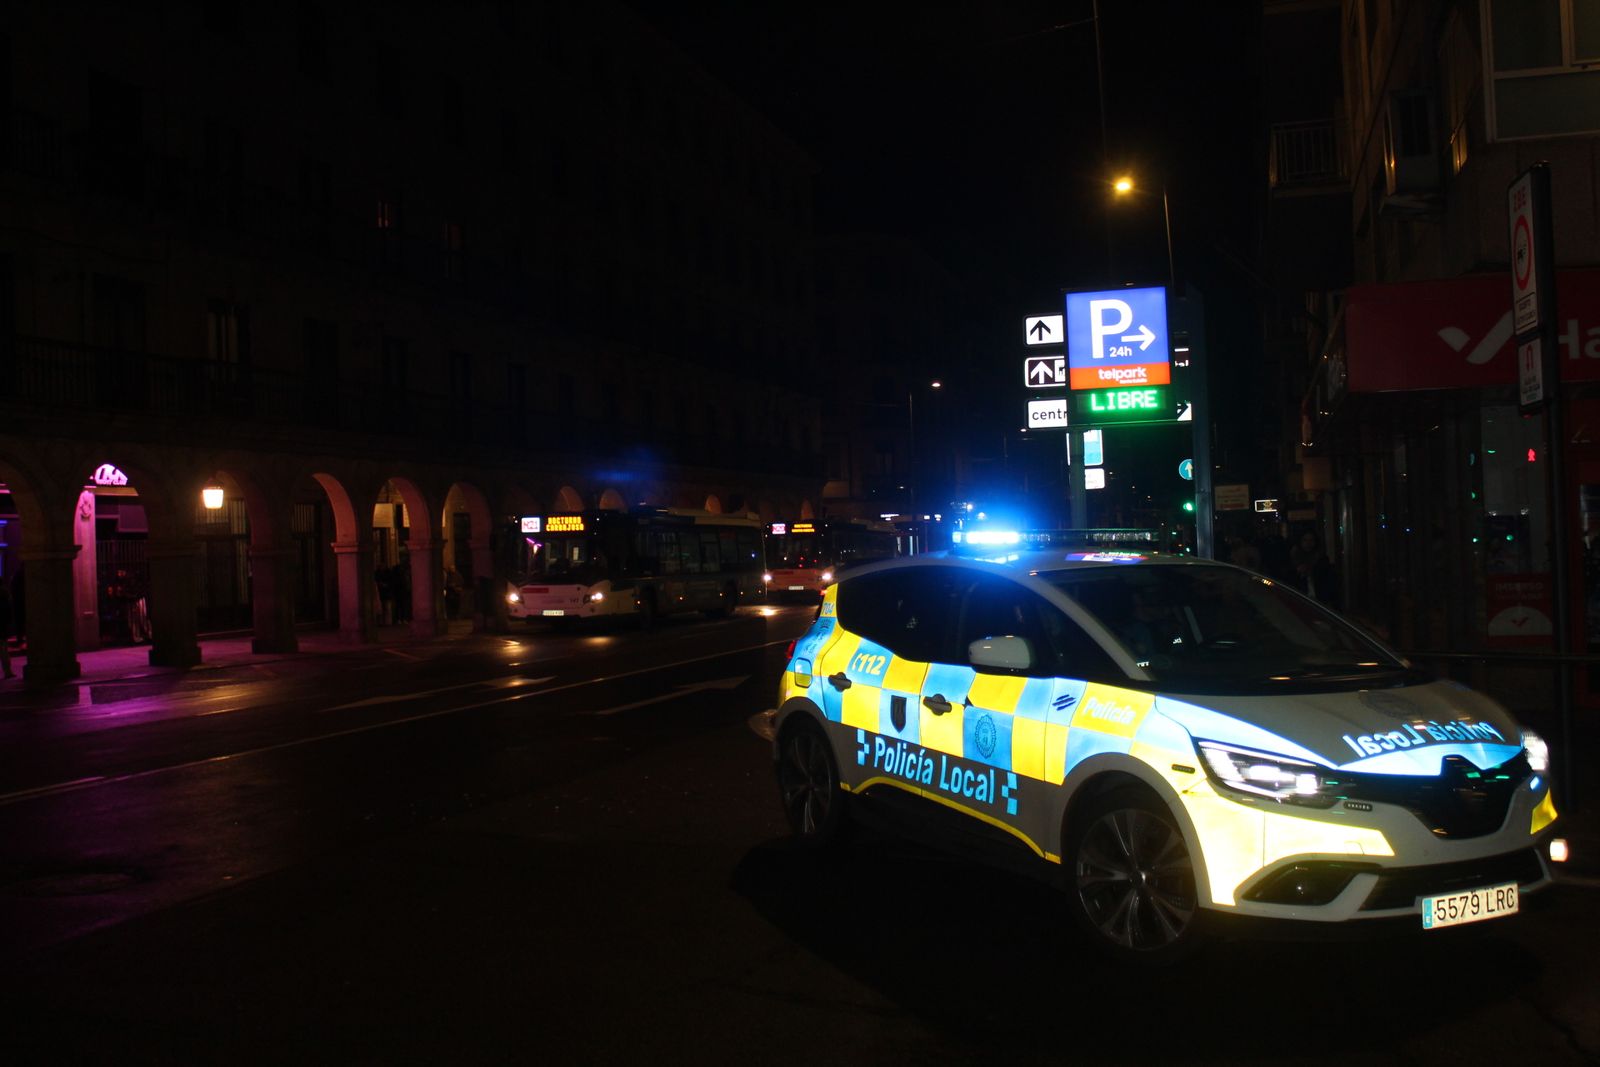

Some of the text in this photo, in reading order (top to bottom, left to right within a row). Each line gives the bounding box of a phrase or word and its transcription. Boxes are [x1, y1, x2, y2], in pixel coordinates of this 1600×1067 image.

[1089, 299, 1133, 359] P
[1109, 346, 1132, 358] 24h
[1098, 366, 1148, 381] telpark
[1091, 390, 1158, 411] LIBRE
[857, 653, 886, 675] 112
[874, 736, 995, 804] Policía Local
[1436, 894, 1480, 921] 5579
